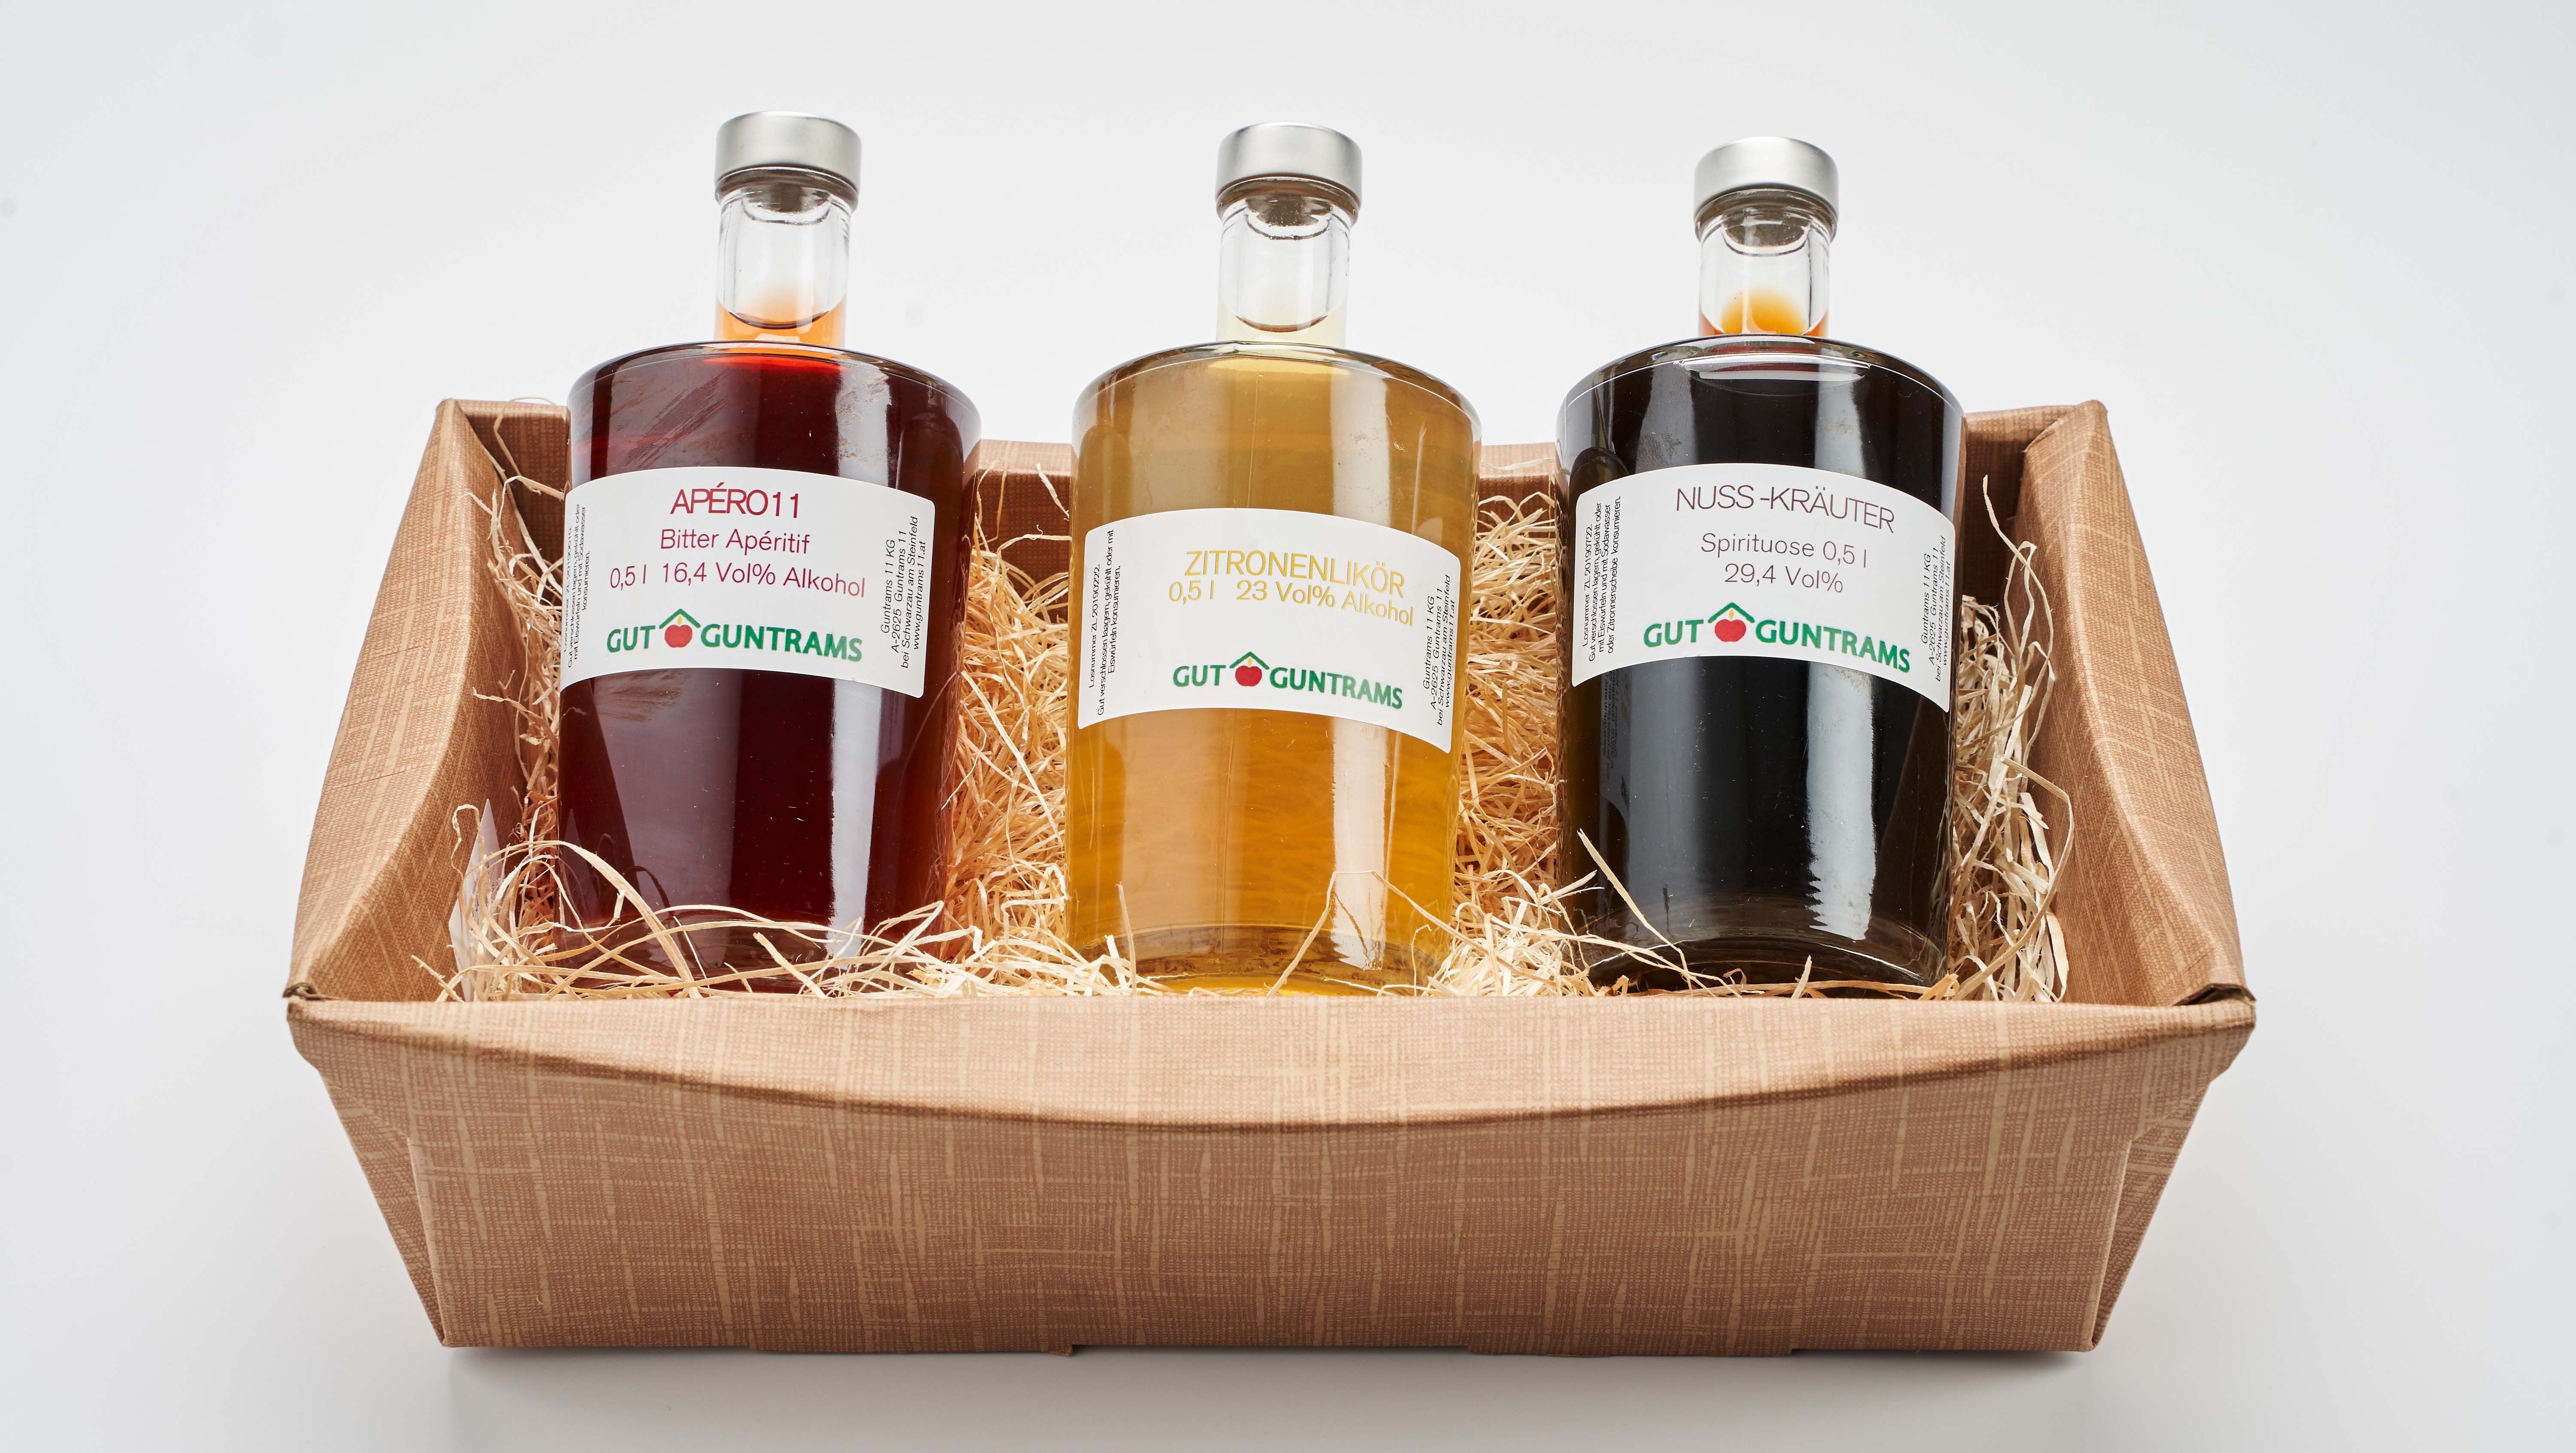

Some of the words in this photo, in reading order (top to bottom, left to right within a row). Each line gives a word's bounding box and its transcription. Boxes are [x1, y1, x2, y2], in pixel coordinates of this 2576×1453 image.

[670, 482, 799, 519] APÉRO11
[661, 529, 720, 549] Bitter
[726, 529, 810, 556] Apéritif
[898, 531, 906, 542] 11
[907, 517, 917, 565] Steinfeld
[1601, 505, 1610, 557] Sodawasser
[1611, 496, 1621, 554] konsumieren.
[885, 562, 893, 573] 11
[886, 540, 895, 557] KG
[1701, 533, 1814, 558] Spirituose
[1823, 541, 1855, 565] 0,5
[1924, 553, 1931, 571] KG
[1932, 547, 1938, 559] 11
[582, 551, 590, 610] konsumieren.
[611, 566, 635, 590] 0,5
[663, 562, 707, 586] 16,4
[716, 562, 775, 585] Vol%
[783, 567, 865, 597] Alkohol
[894, 548, 905, 602] Guntrams
[908, 569, 914, 585] am
[914, 541, 926, 649] www.guntrams11.at
[1111, 565, 1121, 625] konsumieren.
[1185, 550, 1404, 600] ZITRONENLIKÖR
[1436, 588, 1442, 600] 11
[1725, 563, 1776, 587] 29,4
[1785, 566, 1843, 593] Vol%
[1923, 575, 1930, 587] 11
[1939, 586, 1944, 602] am
[881, 580, 893, 633] Guntrams
[902, 589, 913, 648] Schwarzau
[1170, 580, 1202, 605] 0,5
[1236, 580, 1267, 601] 23
[1276, 581, 1335, 608] Vol%
[1341, 590, 1413, 626] Alkohol
[1426, 618, 1433, 630] 11
[1427, 596, 1434, 614] KG
[1598, 592, 1606, 638] Eiswürfeln
[1921, 592, 1929, 644] Guntrams
[607, 625, 656, 653] GUT
[701, 624, 862, 662] GUNTRAMS
[891, 609, 901, 653] A-2625
[1108, 627, 1116, 673] Eiswürfeln
[1433, 605, 1442, 659] Guntrams
[1443, 627, 1447, 644] am
[1643, 619, 1704, 647] GUT
[1755, 619, 1910, 673] GUNTRAMS
[901, 651, 909, 668] bei
[1423, 636, 1432, 689] Guntrams
[1446, 600, 1455, 708] www.guntrams11.at
[1173, 665, 1226, 687] GUT
[1269, 667, 1402, 709] GUNTRAMS
